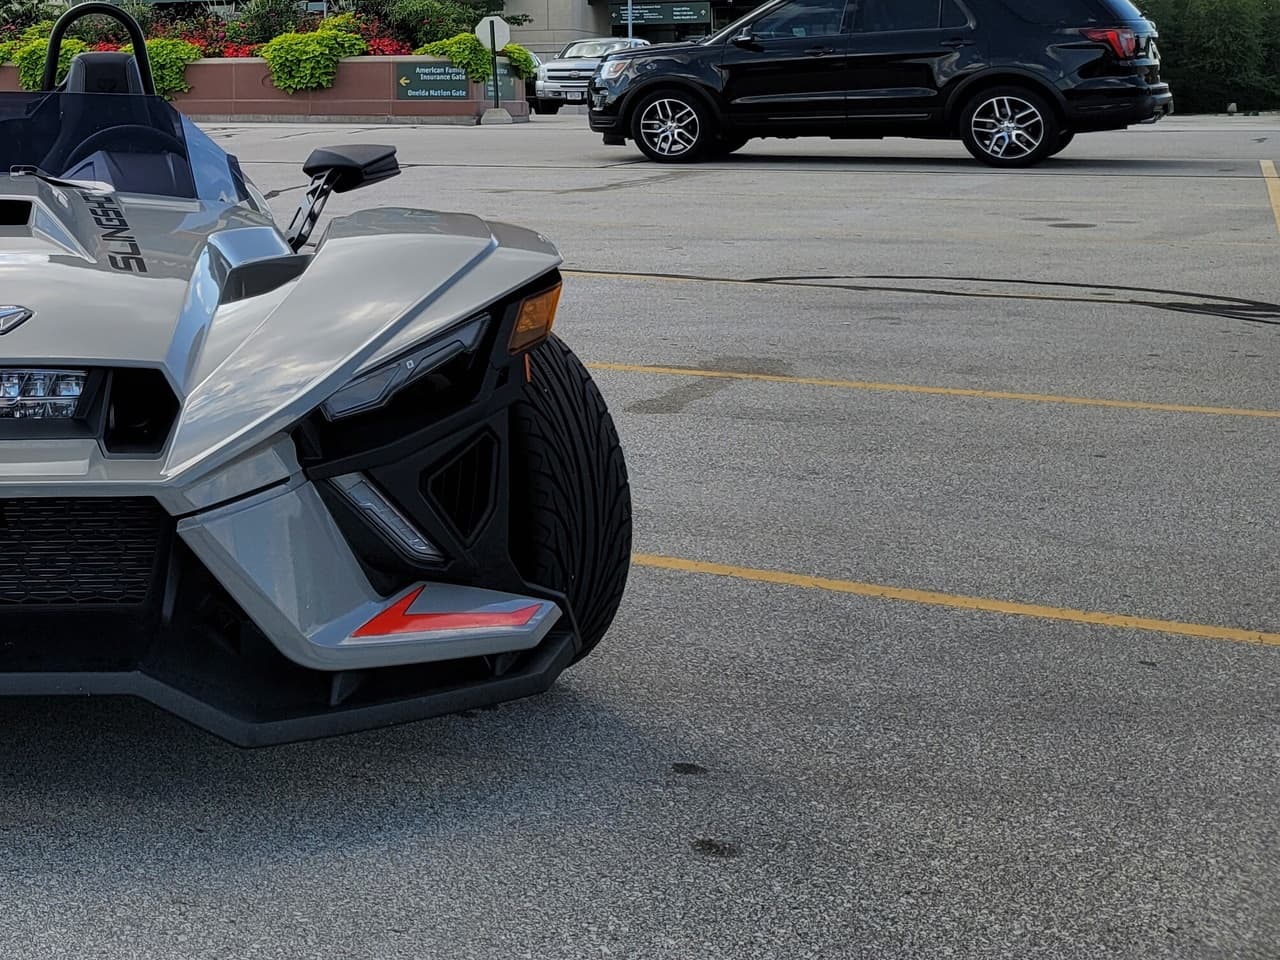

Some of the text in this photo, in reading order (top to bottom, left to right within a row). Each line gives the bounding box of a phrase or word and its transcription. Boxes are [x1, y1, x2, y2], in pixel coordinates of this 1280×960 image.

[416, 66, 445, 74] American
[420, 73, 466, 81] Insurance Gate
[407, 89, 466, 97] Oneida Nation Gate
[80, 193, 148, 273] SLINGSHO
